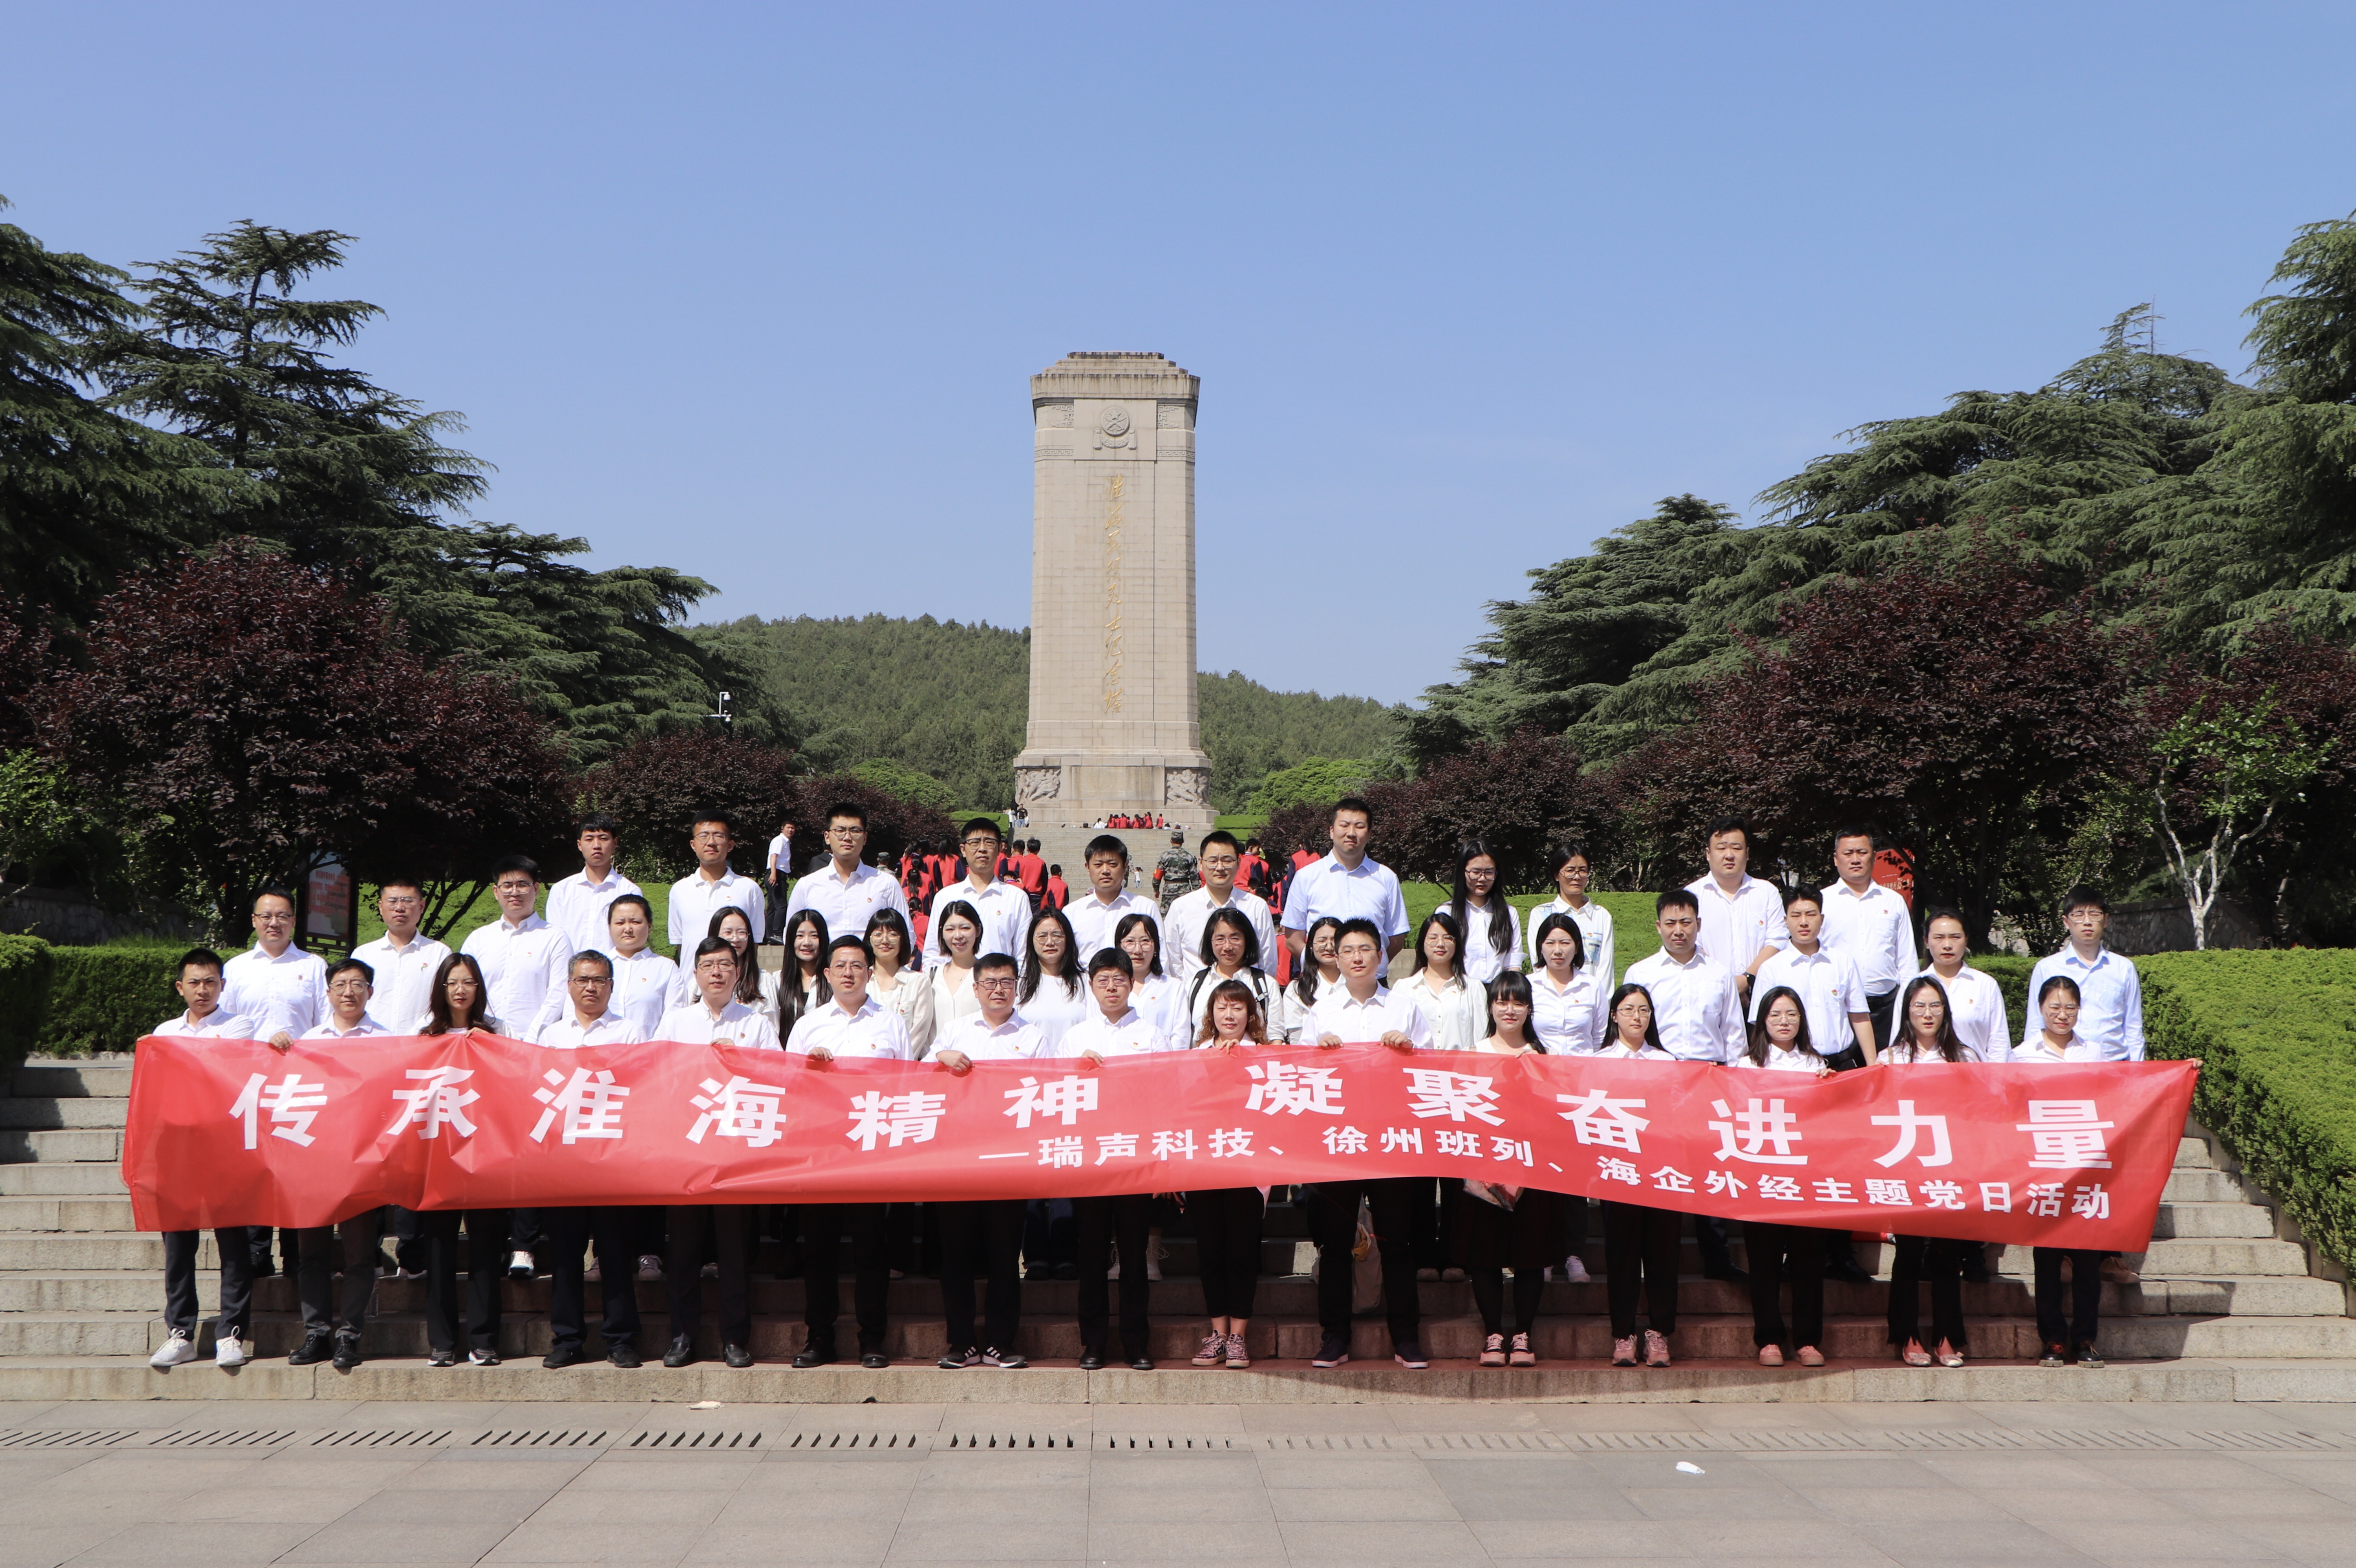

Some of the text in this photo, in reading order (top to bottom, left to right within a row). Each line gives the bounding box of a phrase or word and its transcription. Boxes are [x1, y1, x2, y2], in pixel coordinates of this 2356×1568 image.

[229, 1061, 2115, 1169] 传承淮海精神 凝聚奋进力量
